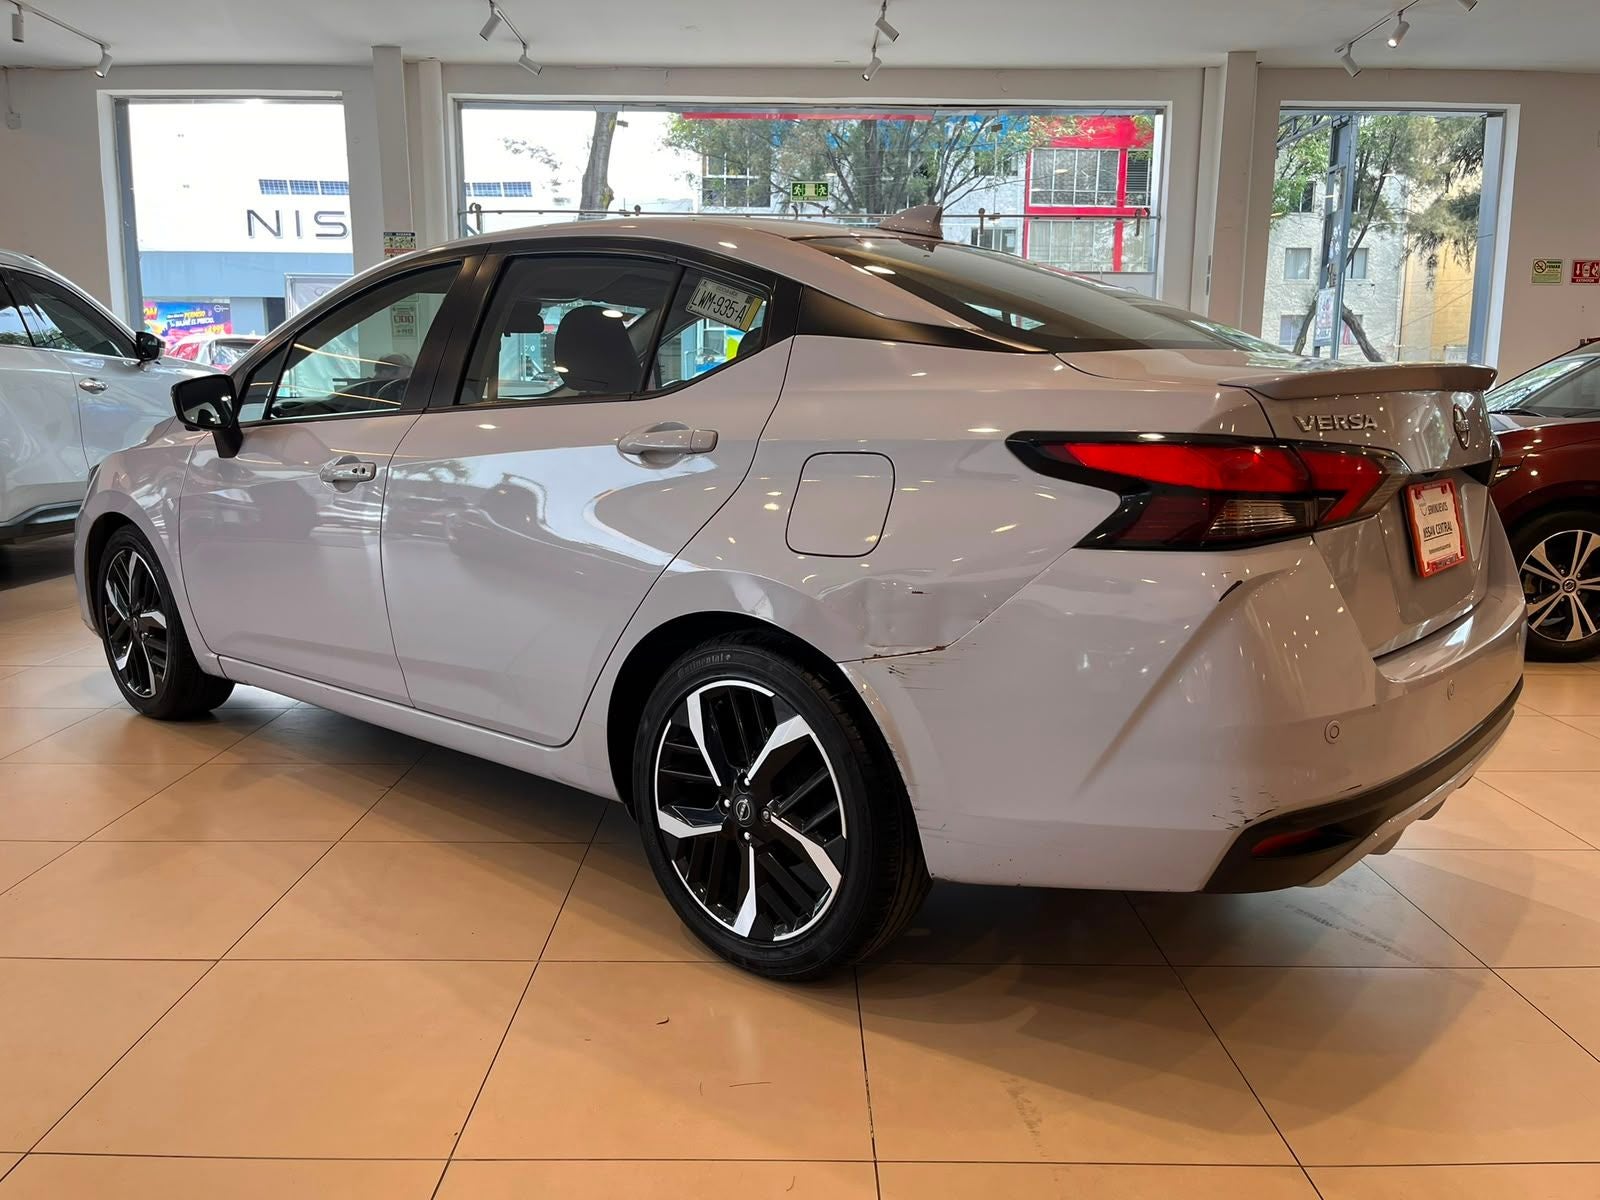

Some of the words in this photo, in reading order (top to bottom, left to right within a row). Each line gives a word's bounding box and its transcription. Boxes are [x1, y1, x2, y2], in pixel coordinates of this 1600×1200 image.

[691, 288, 747, 323] LWM-935-A
[1293, 414, 1378, 432] VERSA
[1435, 521, 1453, 535] CENTRAL
